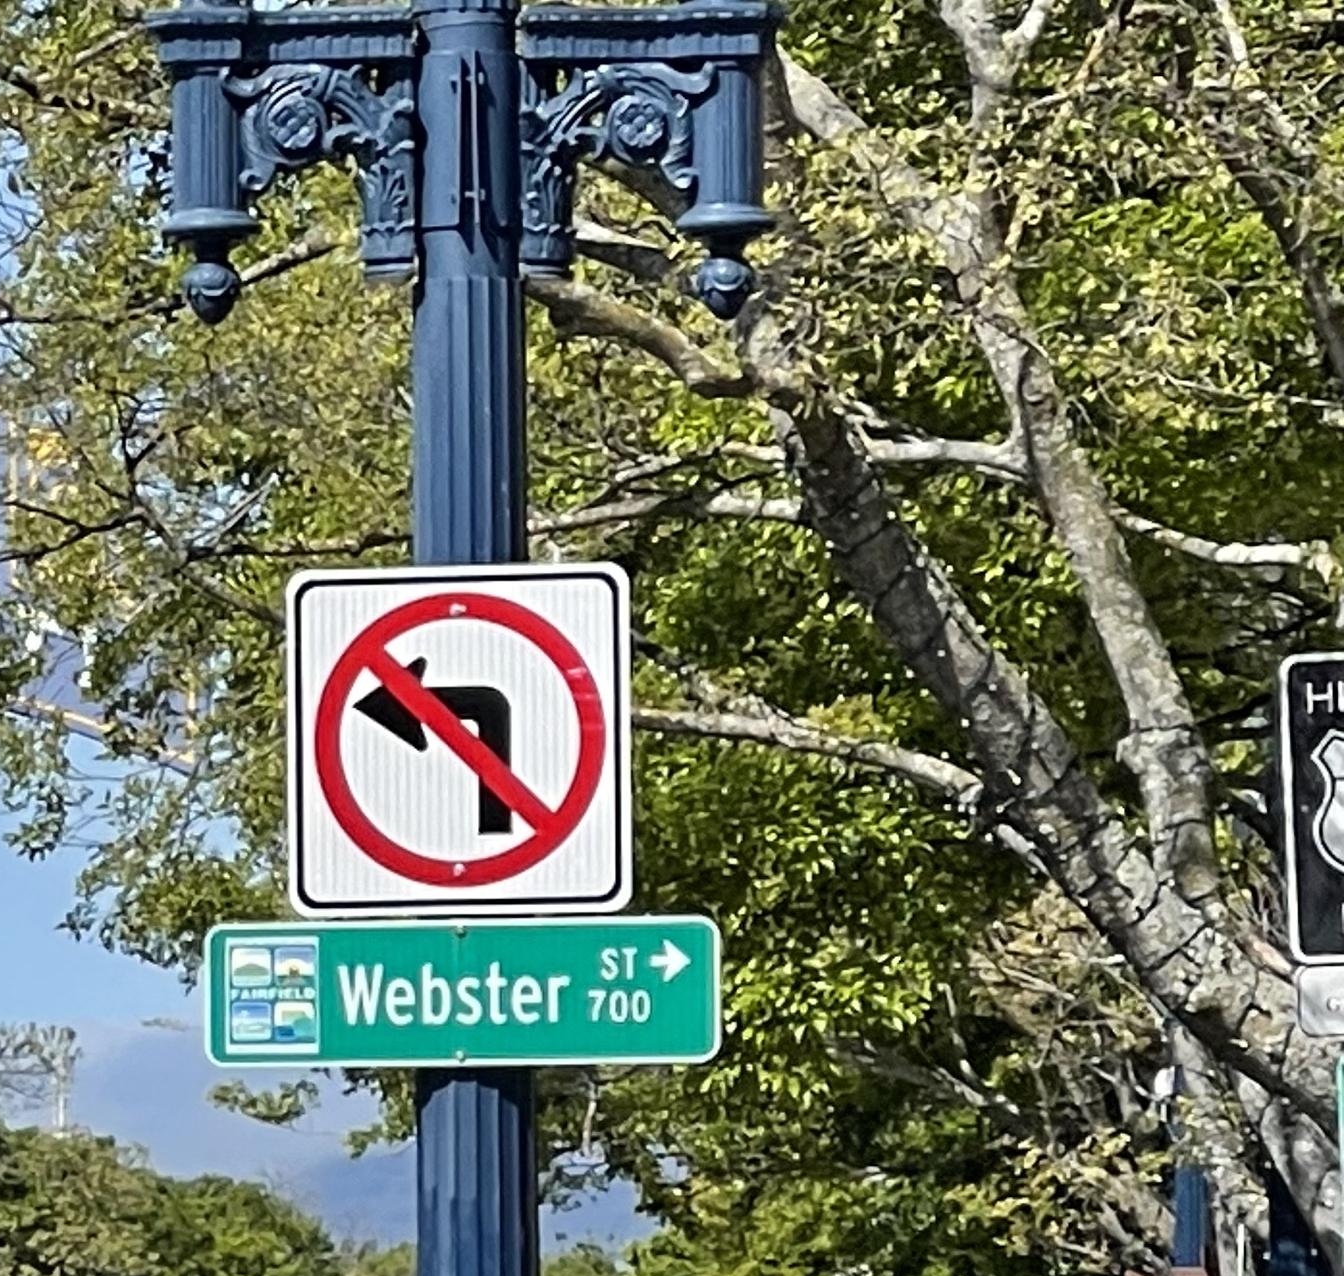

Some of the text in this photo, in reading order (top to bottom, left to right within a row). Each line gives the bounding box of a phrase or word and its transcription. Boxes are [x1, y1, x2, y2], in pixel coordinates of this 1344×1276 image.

[599, 947, 639, 981] ST
[337, 961, 570, 1027] Webster
[588, 989, 652, 1024] 700
